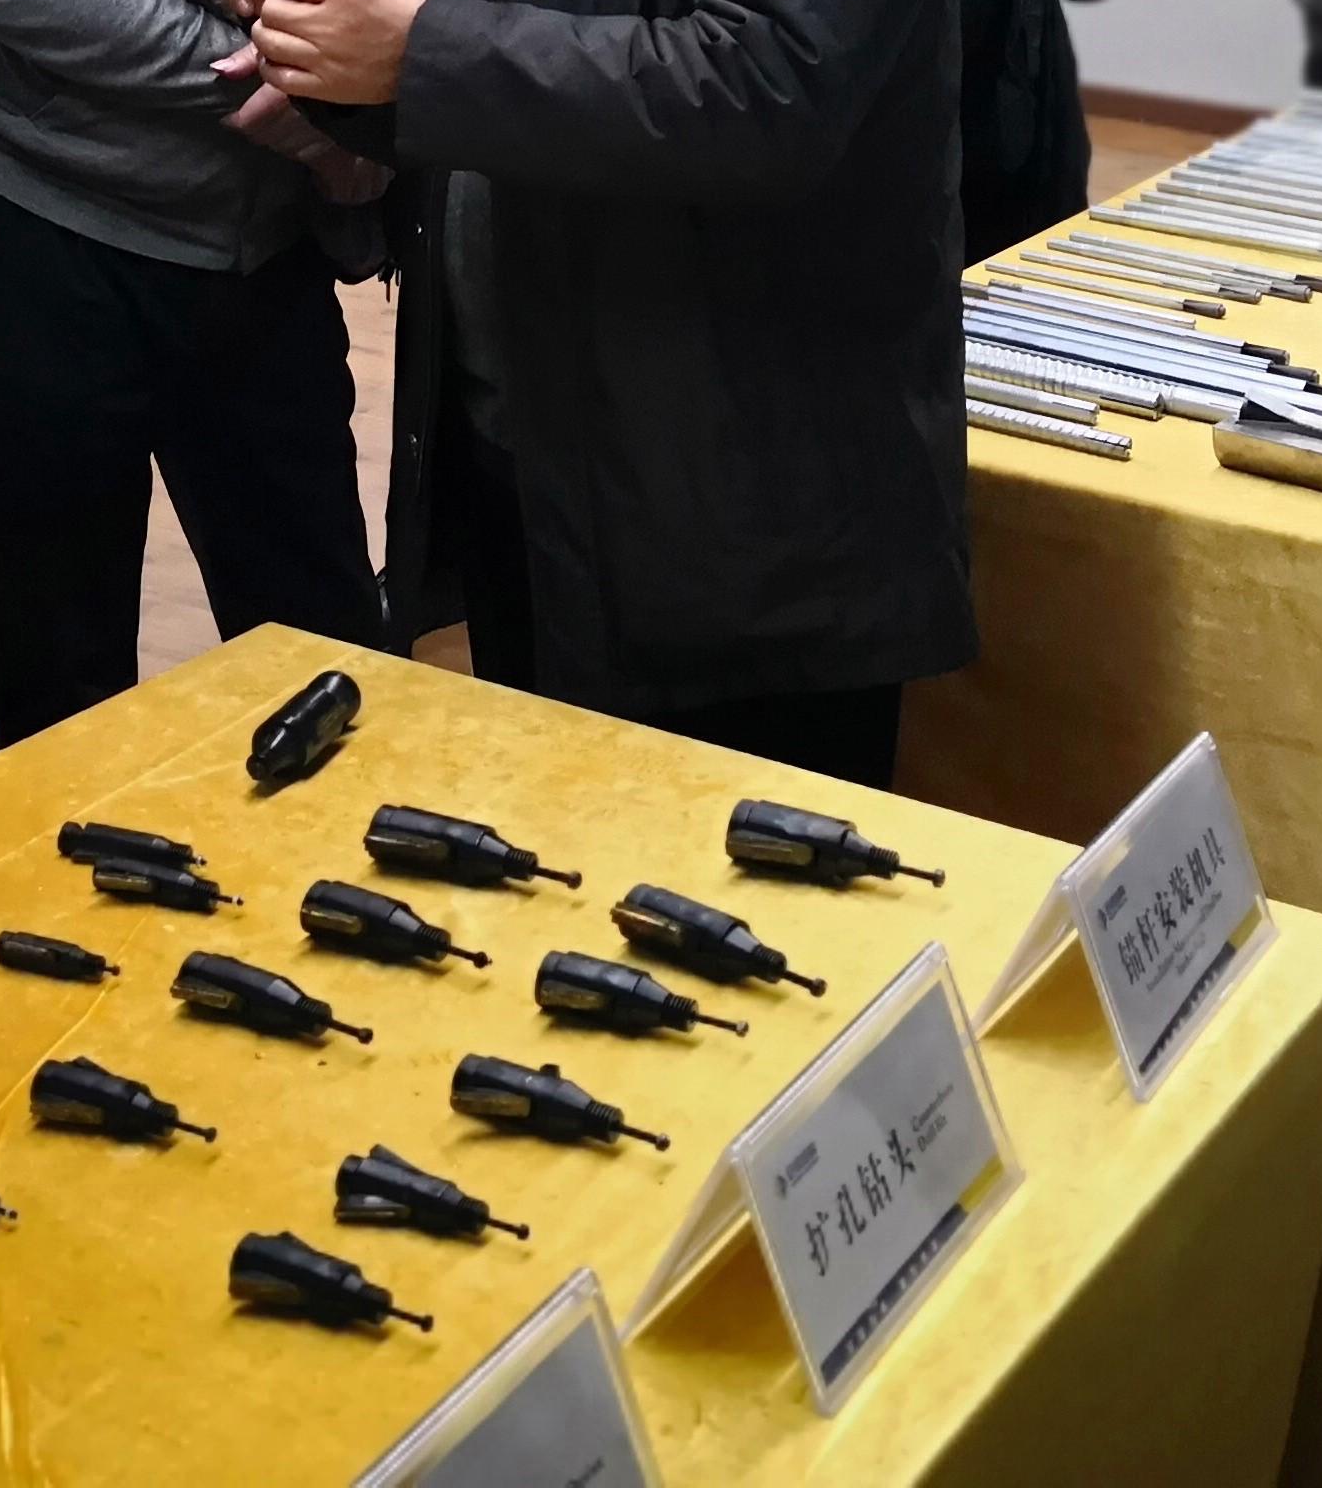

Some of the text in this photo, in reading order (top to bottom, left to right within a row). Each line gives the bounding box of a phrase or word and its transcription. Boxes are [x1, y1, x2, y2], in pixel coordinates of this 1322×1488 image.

[1118, 827, 1226, 986] 锚杆安装机具
[804, 1128, 916, 1277] 扩孔钻头
